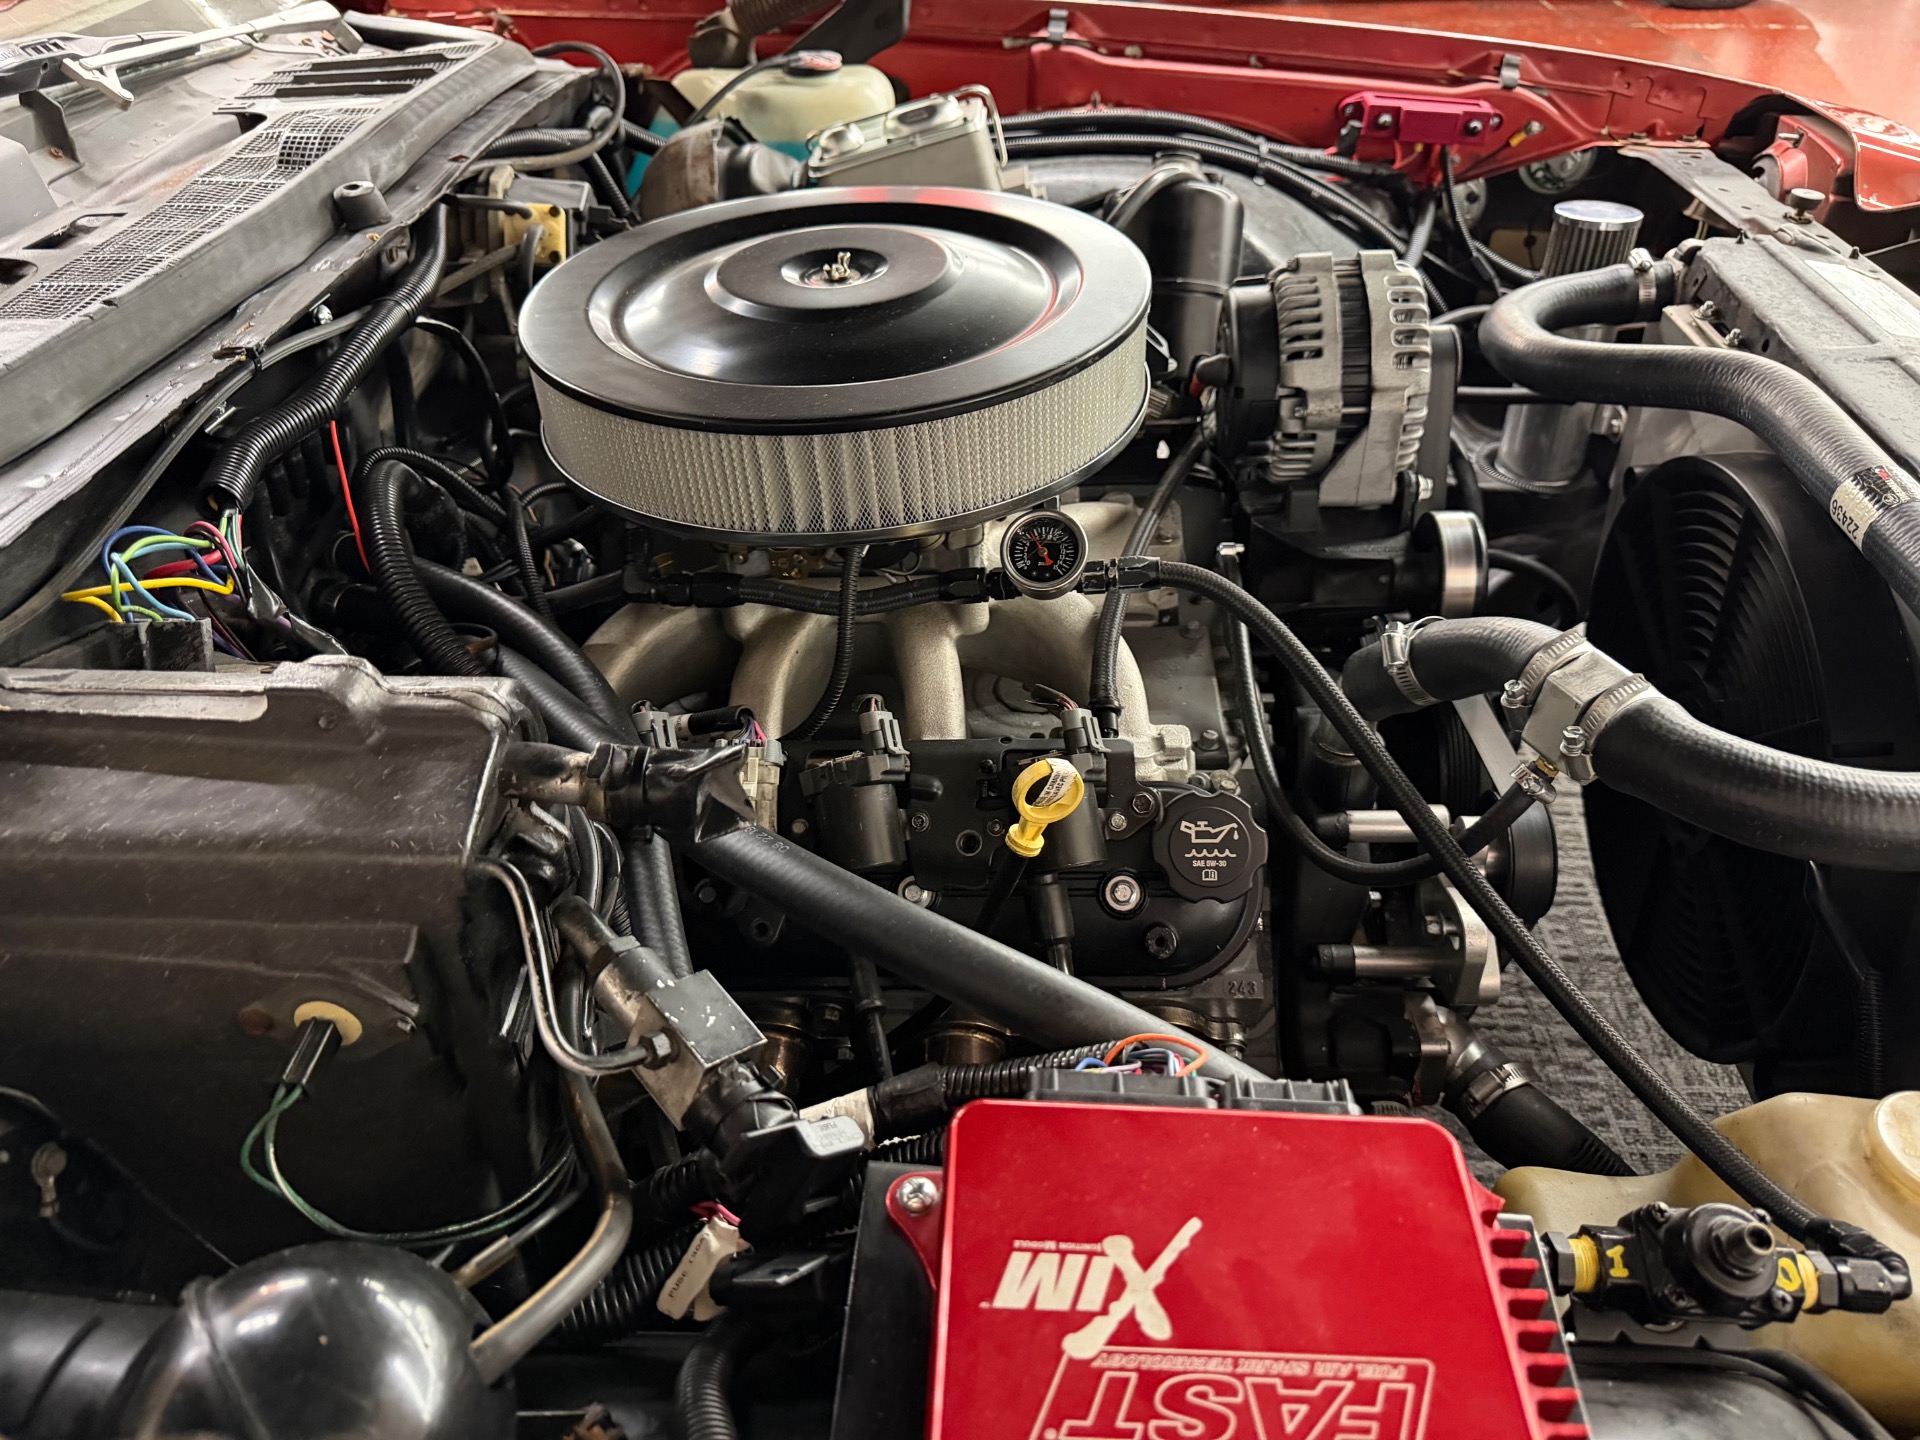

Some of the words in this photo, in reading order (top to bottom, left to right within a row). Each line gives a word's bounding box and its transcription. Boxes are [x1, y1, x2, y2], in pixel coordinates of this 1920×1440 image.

[1831, 499, 1860, 540] 22436
[1192, 860, 1205, 868] SAE
[1206, 860, 1227, 868] 5W-30
[1228, 980, 1256, 995] 243
[1013, 1239, 1057, 1251] MODULE
[668, 1270, 688, 1298] FUSE
[1090, 1351, 1234, 1374] TECHNOLOGY
[1235, 1357, 1311, 1377] SPARK
[1313, 1360, 1355, 1378] AIR
[1355, 1362, 1408, 1381] FUEL
[1057, 1370, 1416, 1440] FAST
